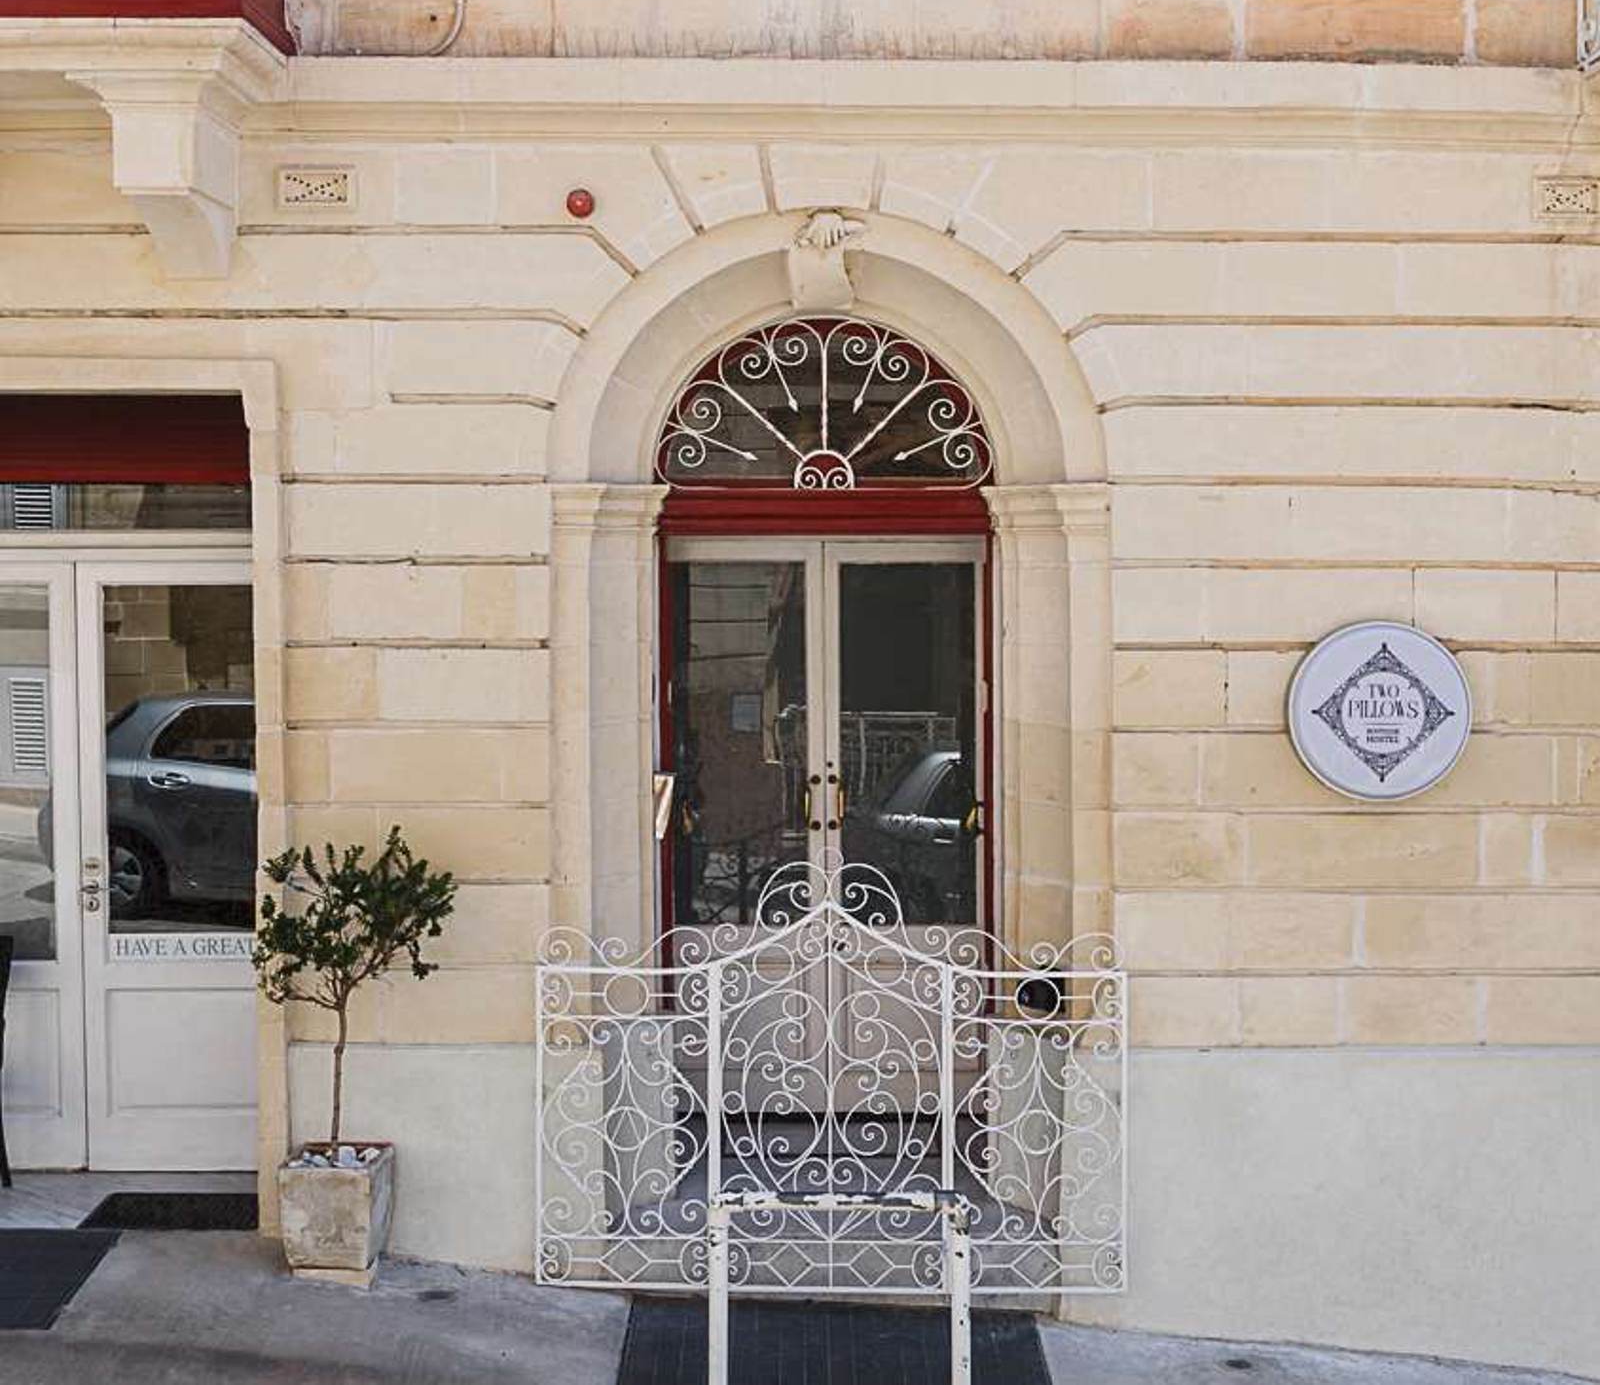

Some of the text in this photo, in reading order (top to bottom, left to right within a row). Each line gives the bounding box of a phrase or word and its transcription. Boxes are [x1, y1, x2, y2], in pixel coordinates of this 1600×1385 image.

[1369, 684, 1400, 698] TWO
[1348, 700, 1419, 719] PILLOWS
[116, 937, 256, 956] HAVE A GREAT
